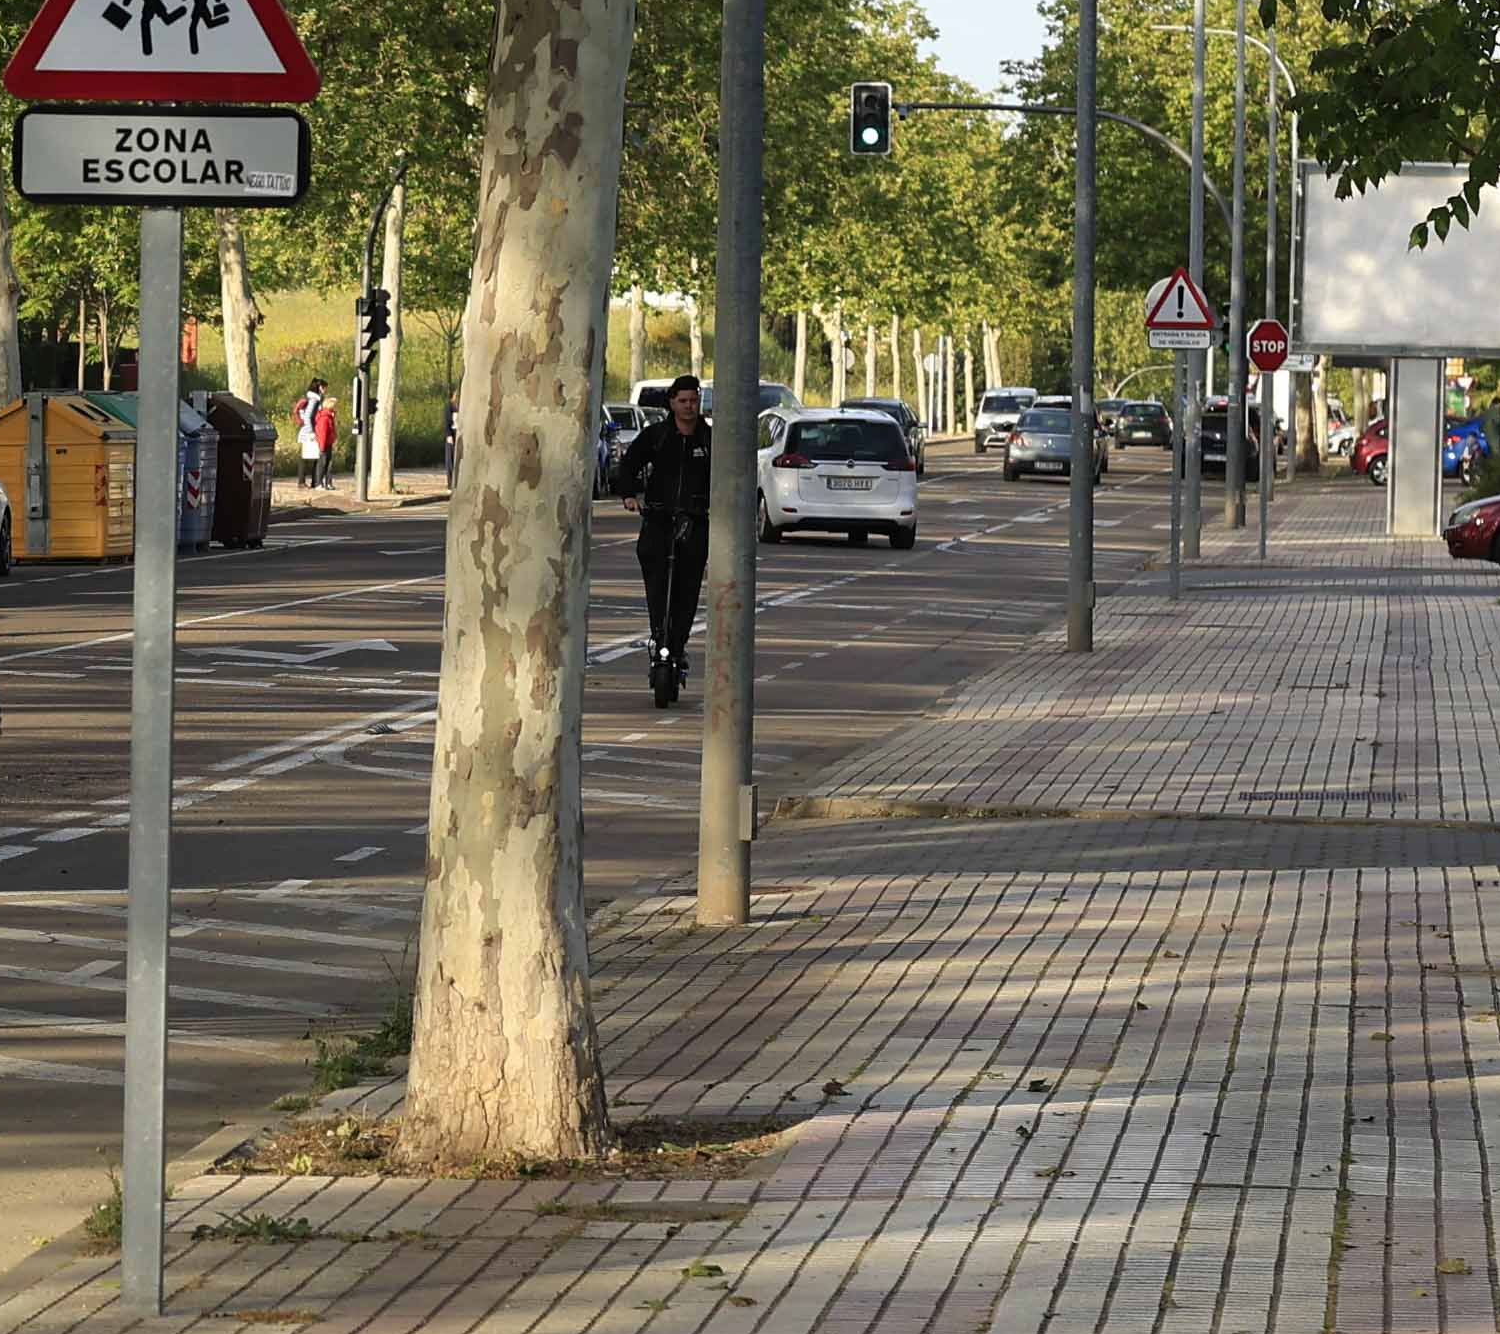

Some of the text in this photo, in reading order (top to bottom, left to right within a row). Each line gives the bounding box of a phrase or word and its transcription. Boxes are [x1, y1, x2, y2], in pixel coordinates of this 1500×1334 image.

[115, 127, 212, 153] ZONA
[82, 158, 246, 184] ESCOLAR
[1252, 340, 1285, 353] STOP
